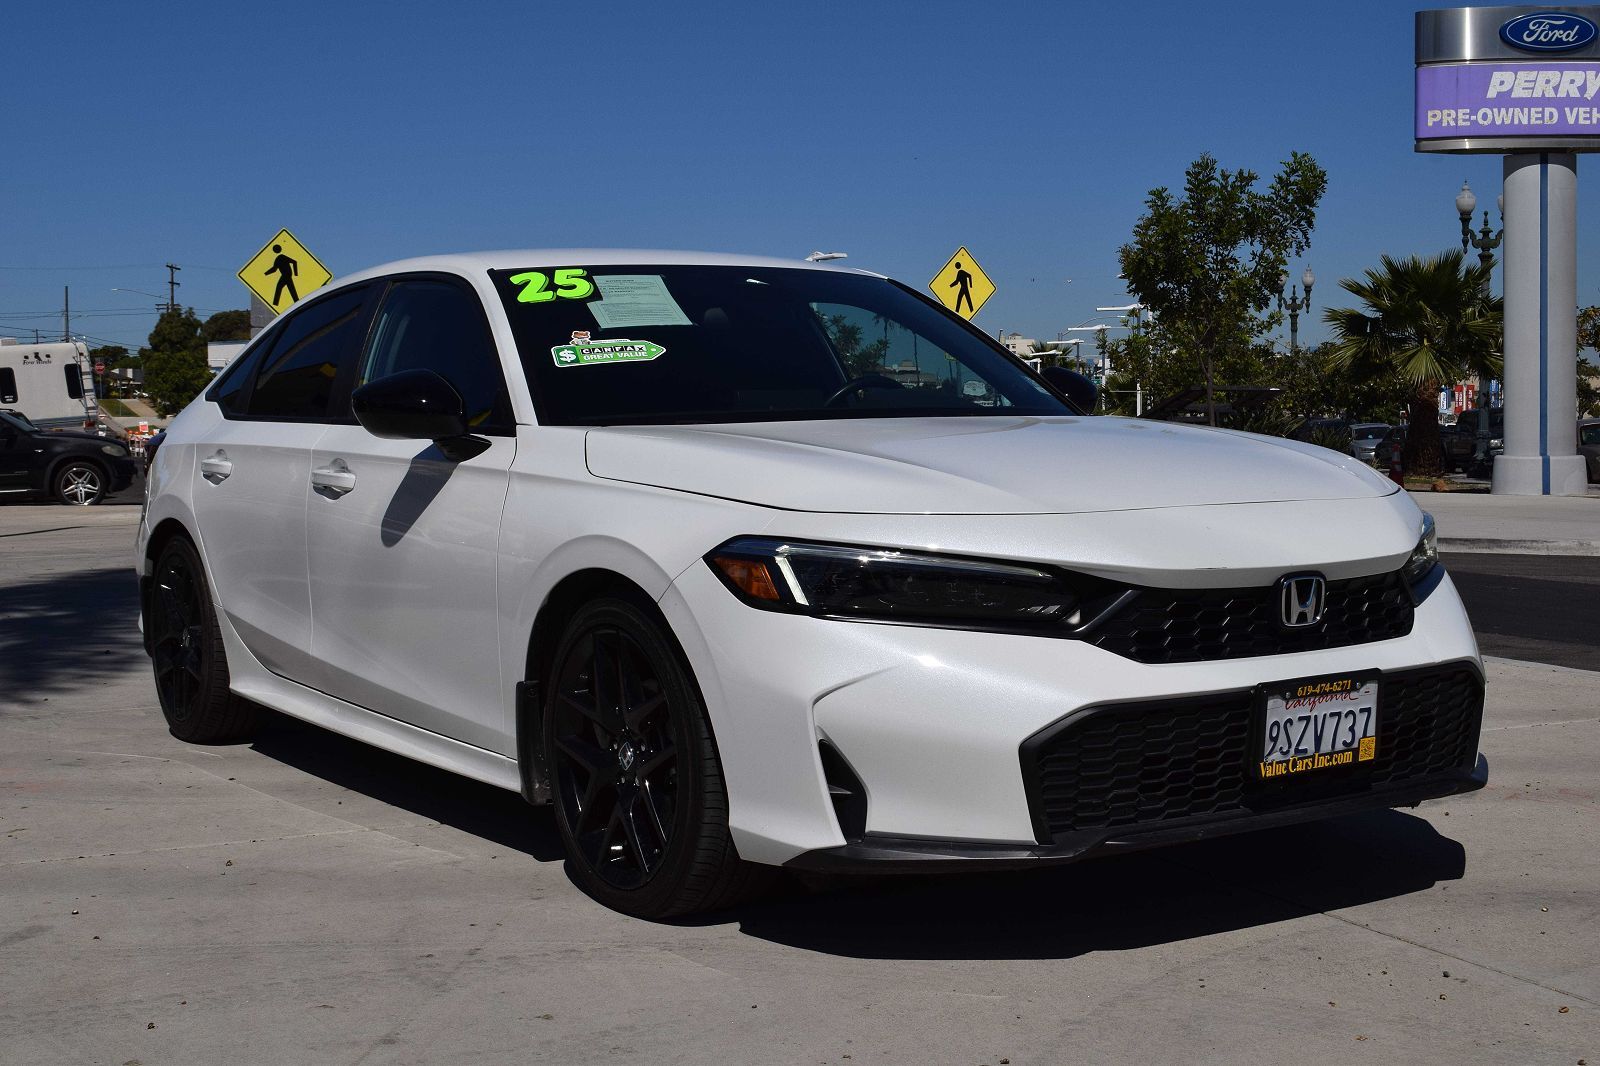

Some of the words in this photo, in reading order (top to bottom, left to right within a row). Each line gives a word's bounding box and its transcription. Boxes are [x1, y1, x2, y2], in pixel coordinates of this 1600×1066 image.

[1523, 19, 1579, 42] Ford
[1486, 70, 1600, 100] PERRY
[1427, 107, 1559, 127] PRE-OWNED
[509, 268, 595, 304] 25
[581, 345, 647, 355] CARFAX
[583, 353, 614, 361] GREAT
[616, 351, 648, 359] VALUE
[1296, 679, 1352, 697] 619-474-6271
[1264, 706, 1372, 759] 9SZV737
[1288, 755, 1313, 774] Cars
[1312, 751, 1353, 769] Inc.com
